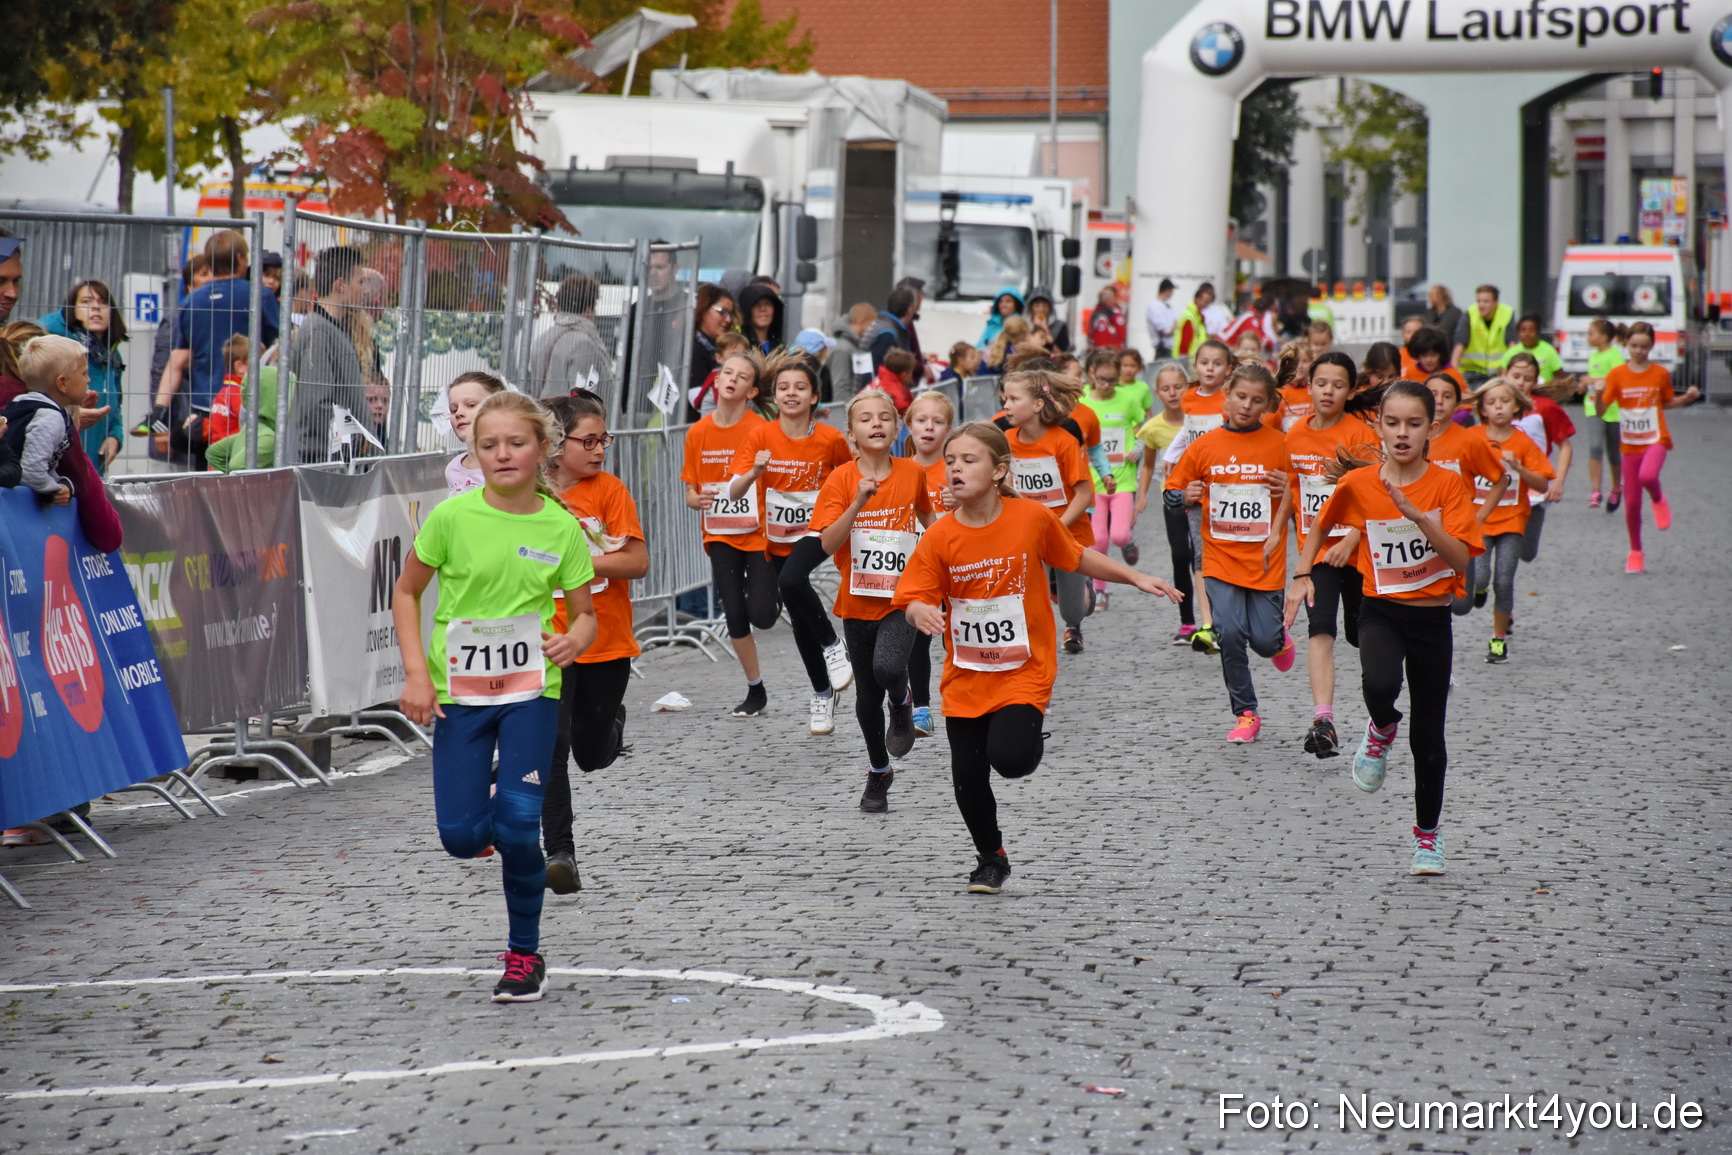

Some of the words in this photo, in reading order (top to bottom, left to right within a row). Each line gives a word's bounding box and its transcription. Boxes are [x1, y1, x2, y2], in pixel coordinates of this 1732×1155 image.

[1265, 0, 1410, 39] BMW
[1427, 0, 1690, 47] Laufsport
[1625, 419, 1650, 430] 7101
[1104, 440, 1118, 452] 37
[1017, 473, 1054, 490] 7069
[713, 498, 750, 514] 7238
[856, 508, 896, 518] eumarkter
[1219, 500, 1261, 519] 7168
[1229, 524, 1250, 532] Leticia
[1381, 538, 1436, 564] 7164
[82, 553, 114, 580] STORE
[860, 549, 906, 573] 7396
[948, 558, 1004, 574] Neumarkter
[952, 568, 994, 583] Stadtlauf
[1402, 567, 1427, 579] Selma
[856, 575, 896, 590] Amelie
[121, 561, 177, 621] OCK
[100, 604, 142, 636] ONLINE
[482, 625, 515, 635] BOCK
[960, 620, 1015, 644] 7193
[461, 641, 529, 671] 7110
[980, 651, 1000, 660] Katja
[119, 659, 161, 691] MOBILE
[489, 680, 505, 690] Lili
